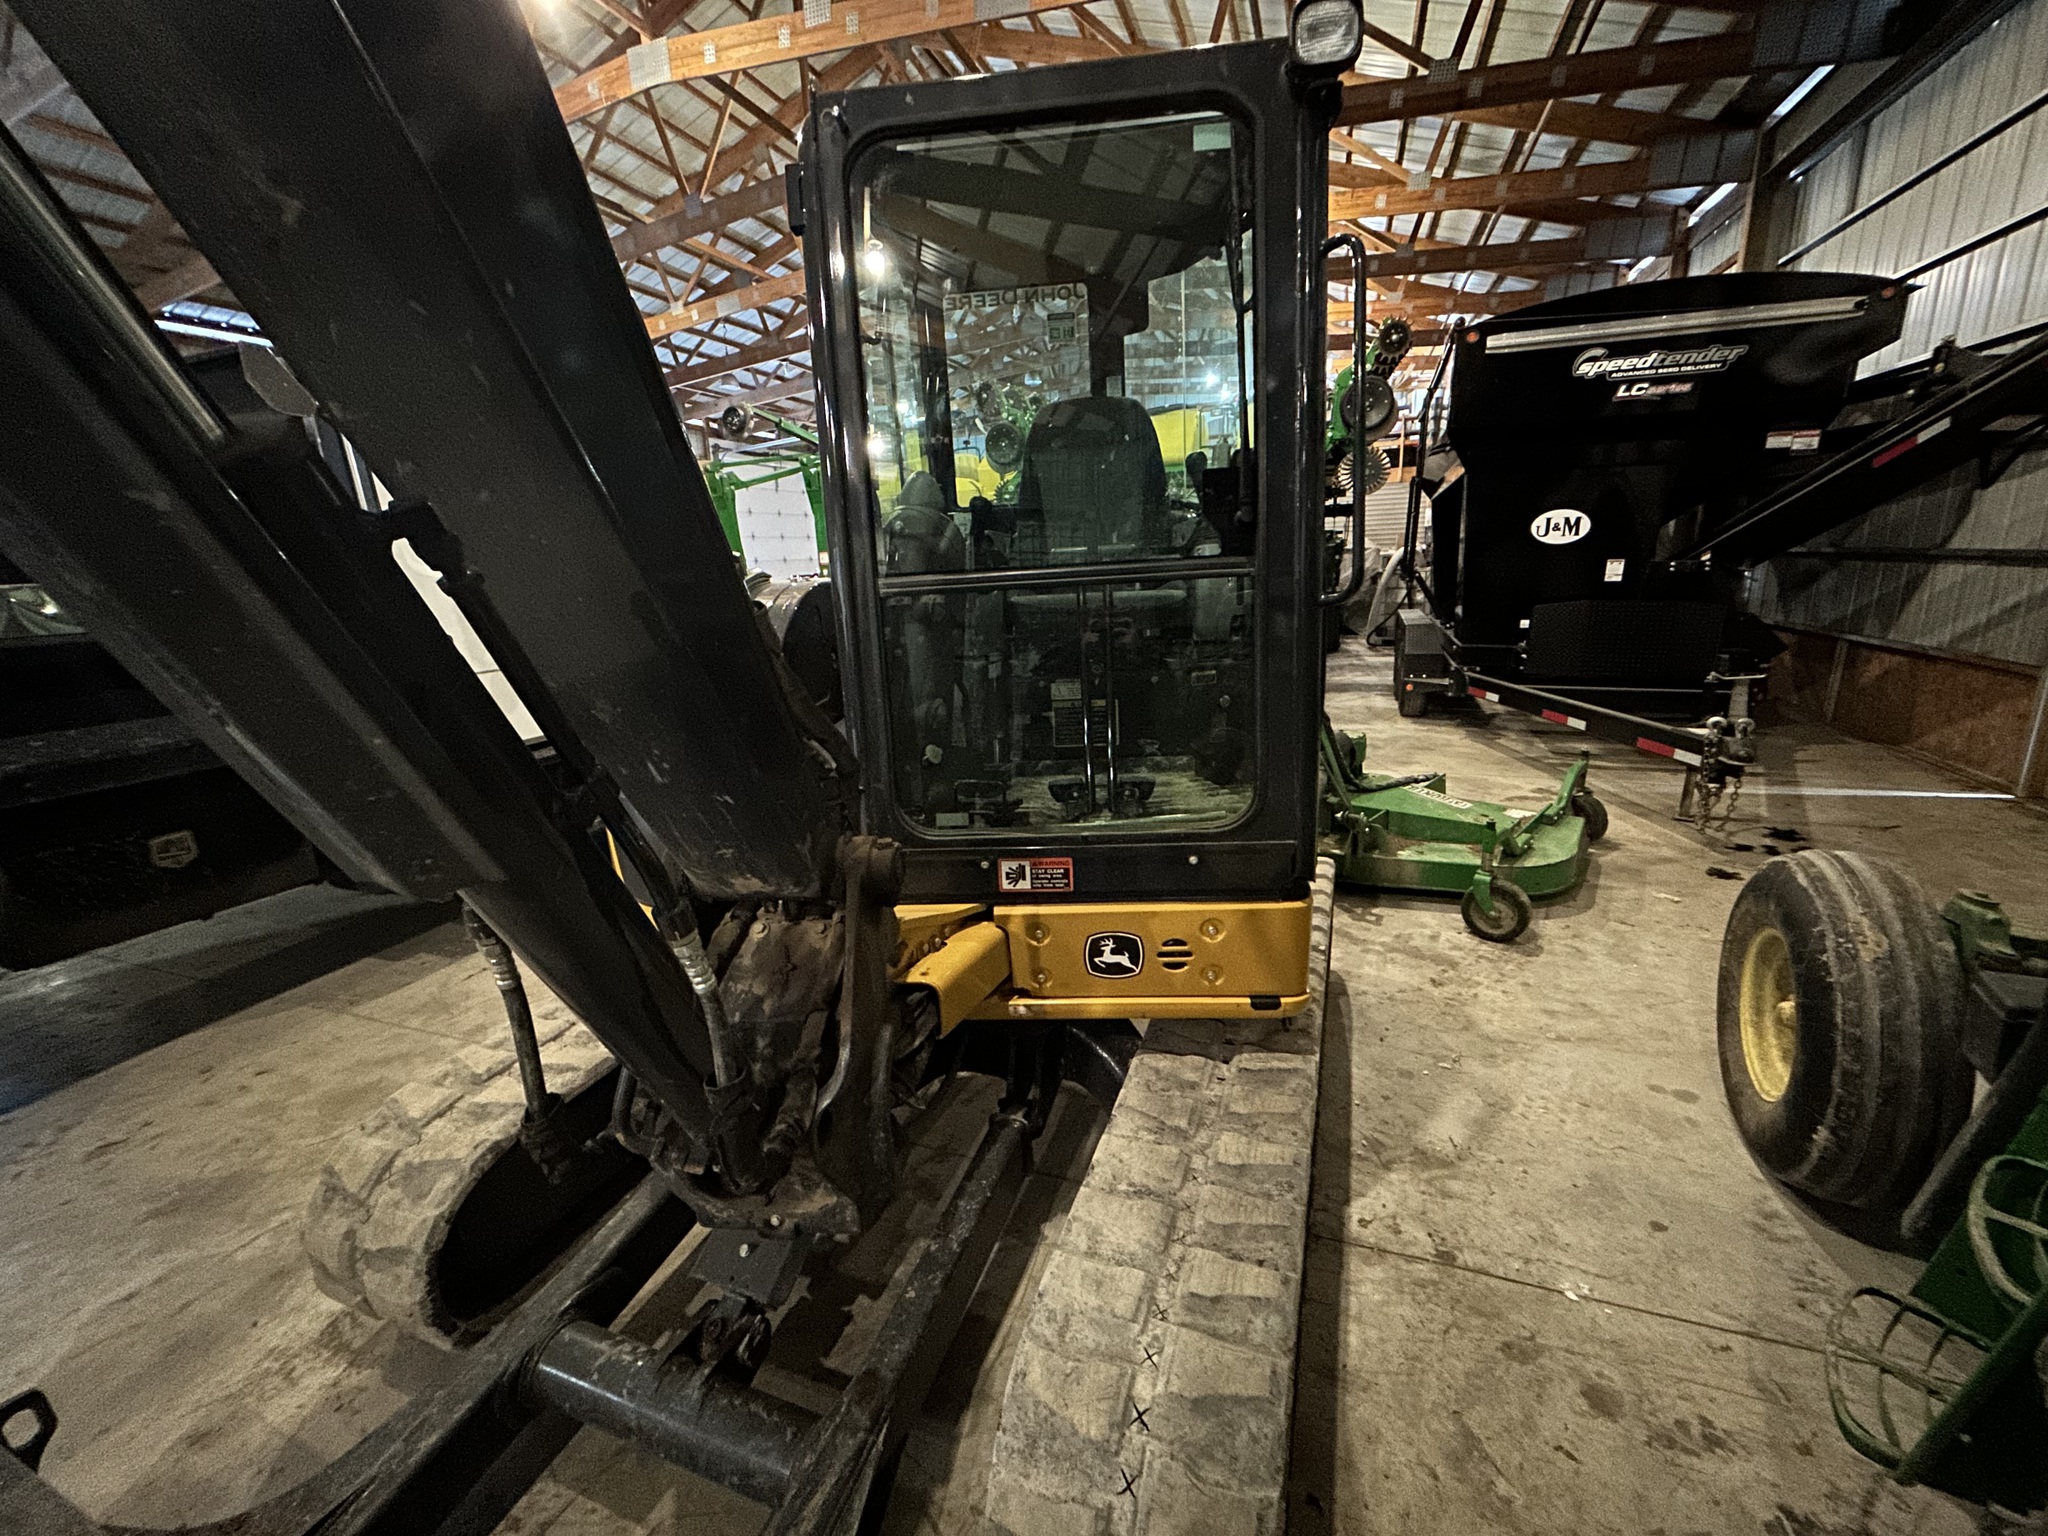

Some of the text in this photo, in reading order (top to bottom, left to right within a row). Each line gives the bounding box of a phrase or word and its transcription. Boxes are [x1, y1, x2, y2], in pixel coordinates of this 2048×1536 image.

[1611, 362, 1723, 378] ADVANCED SEED DELIVERY
[1536, 516, 1583, 538] J&M
